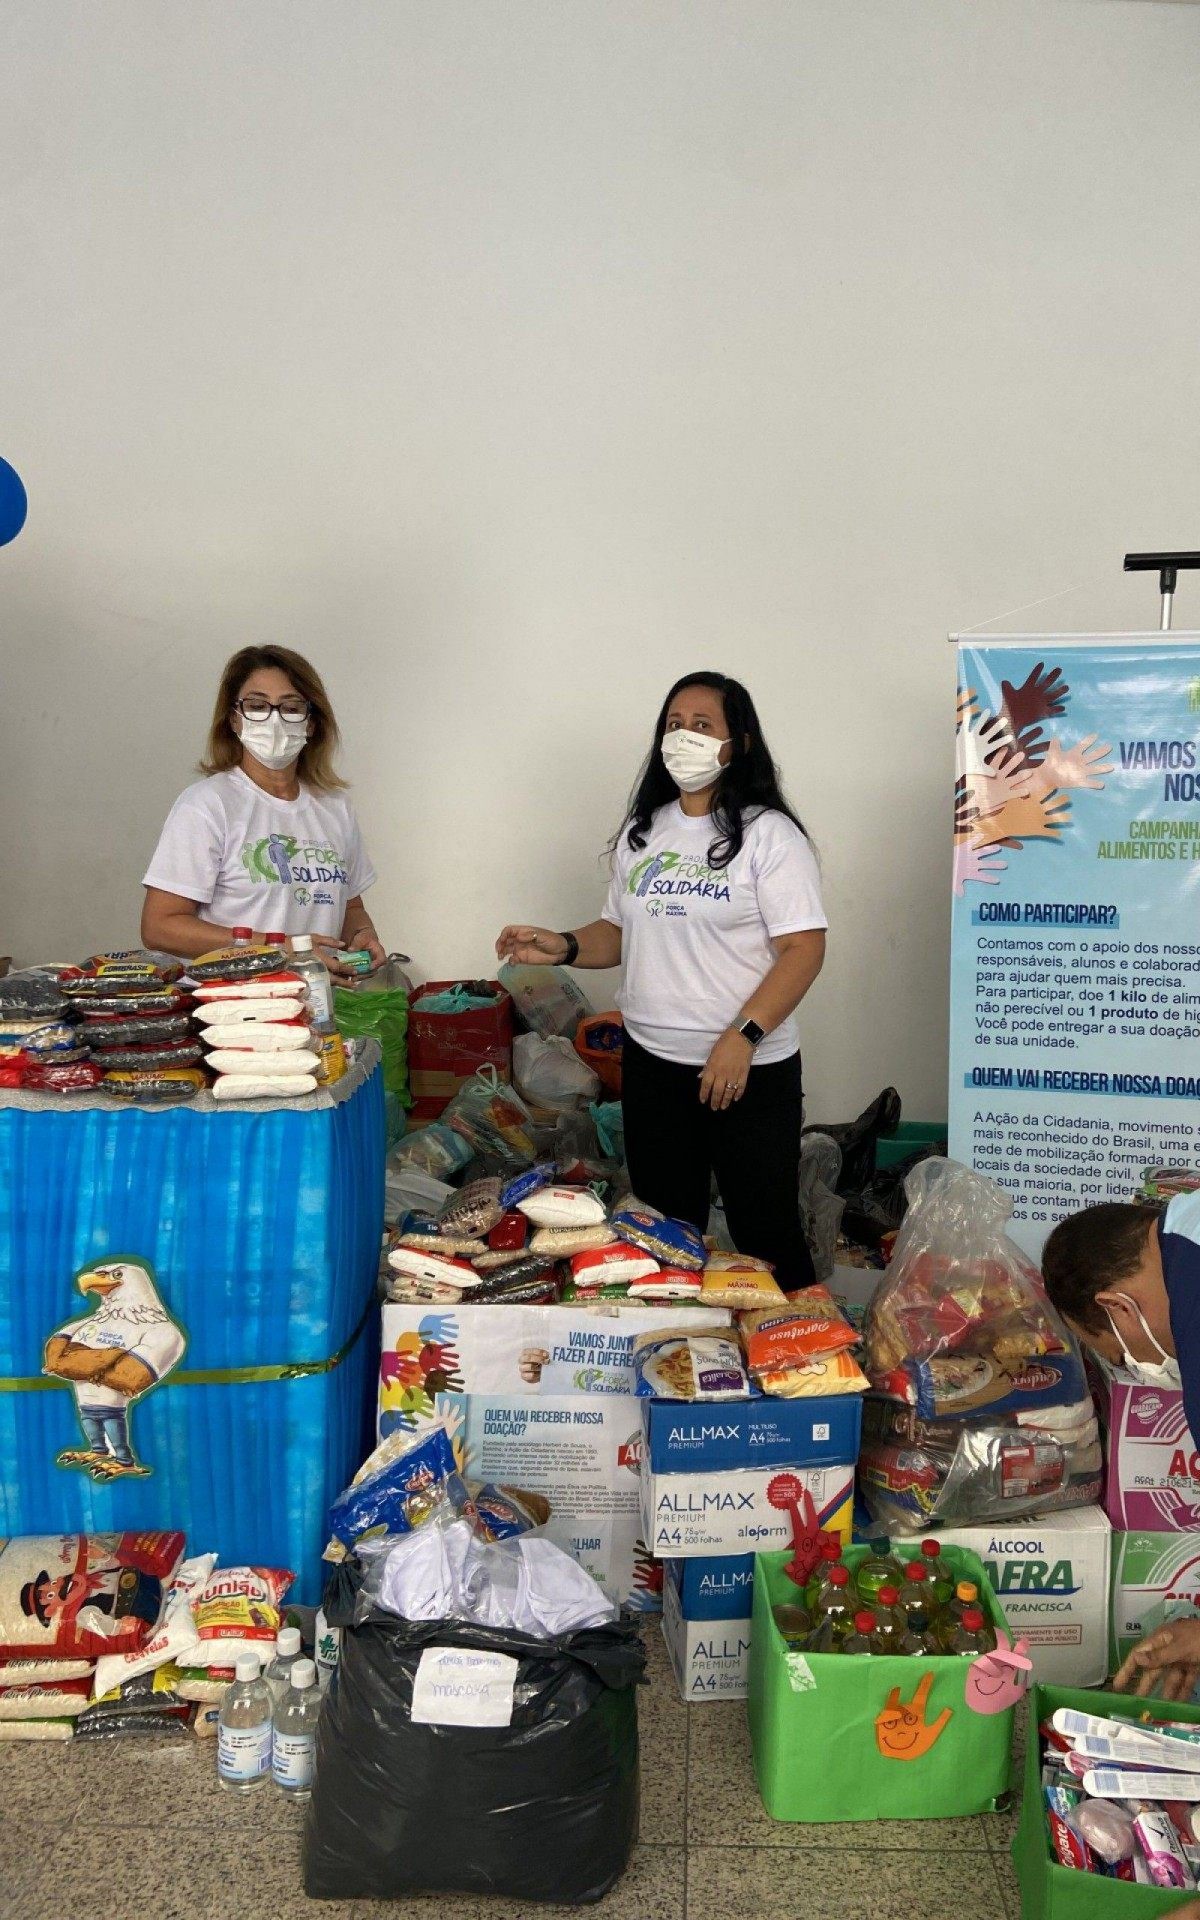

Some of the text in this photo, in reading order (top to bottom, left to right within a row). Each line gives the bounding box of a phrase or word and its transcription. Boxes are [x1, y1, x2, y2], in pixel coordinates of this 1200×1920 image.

[1120, 741, 1196, 769] VAMOS
[1130, 822, 1200, 839] CAMPANH
[304, 848, 345, 866] FOR
[1098, 842, 1175, 860] ALIMENTOS
[1180, 842, 1188, 859] E
[292, 865, 348, 885] SOLIDÁR
[649, 879, 730, 902] SOLIDÁRIA
[979, 902, 1117, 924] COMO PARTICIPAR?
[977, 937, 1043, 950] Contamos
[1047, 941, 1075, 952] com
[1080, 942, 1088, 952] o
[1093, 941, 1130, 954] apoio
[1134, 942, 1158, 953] dos
[977, 954, 1067, 968] responsáveis,
[1071, 959, 1116, 969] alunos
[1120, 960, 1128, 969] e
[976, 971, 1186, 988] para ajudar quem mais precisa.
[976, 986, 1007, 997] Para
[1010, 987, 1074, 1001] participar,
[1078, 990, 1104, 1000] doe
[1109, 990, 1115, 1001] 1
[1121, 991, 1147, 1002] kilo
[1151, 992, 1168, 1003] de
[976, 1002, 1000, 1013] não
[1004, 1002, 1063, 1017] perecível
[1068, 1006, 1084, 1016] ou
[1089, 1006, 1096, 1016] 1
[1101, 1007, 1159, 1020] produto
[1163, 1008, 1180, 1020] de
[975, 1017, 1200, 1040] Você pode entregar a sua doação
[975, 1034, 1079, 1049] de sua unidade.
[972, 1067, 1013, 1087] QUEM
[1016, 1069, 1040, 1088] VAI
[1043, 1070, 1109, 1092] RECEBER
[1112, 1073, 1162, 1095] NOSSA
[973, 1112, 984, 1123] A
[986, 1112, 1019, 1126] Ação
[1023, 1115, 1039, 1126] da
[1043, 1116, 1114, 1131] Cidadania,
[1118, 1121, 1193, 1135] movimento
[973, 1128, 1004, 1140] mais
[1008, 1130, 1088, 1145] reconhecido
[1092, 1135, 1109, 1146] do
[1113, 1136, 1154, 1150] Brasil,
[1159, 1141, 1189, 1152] uma
[973, 1144, 1003, 1155] rede
[1006, 1145, 1022, 1157] de
[1026, 1147, 1104, 1164] mobilização
[1108, 1152, 1164, 1166] formada
[1168, 1157, 1191, 1167] por
[973, 1159, 1010, 1170] locais
[1014, 1161, 1030, 1173] da
[1034, 1163, 1102, 1178] sociedade
[1106, 1168, 1135, 1181] civil,
[997, 1177, 1020, 1187] sua
[1024, 1179, 1076, 1193] maioria,
[1080, 1182, 1102, 1194] por
[1012, 1195, 1080, 1207] ue contam
[1013, 1210, 1028, 1220] os
[1032, 1211, 1047, 1221] os
[569, 1332, 605, 1349] VAMOS
[553, 1347, 585, 1363] FAZER
[587, 1350, 595, 1364] A
[484, 1410, 604, 1424] QUEM VAI RECEBER NOSSA
[484, 1422, 527, 1437] DOAÇÃO?
[668, 1425, 740, 1442] ALLMAX
[749, 1432, 765, 1443] A4
[658, 1492, 755, 1512] ALLMAX
[656, 1514, 706, 1522] PREMIUM
[657, 1528, 681, 1544] A4
[738, 1525, 787, 1541] aloform
[572, 1538, 601, 1550] LHAR
[988, 1538, 1044, 1553] ÁLCOOL
[700, 1572, 753, 1588] ALLMA
[699, 1588, 735, 1596] PREMIUM
[1005, 1603, 1073, 1613] FRANCISCA
[692, 1660, 740, 1670] PREMIUM
[692, 1674, 716, 1690] A4
